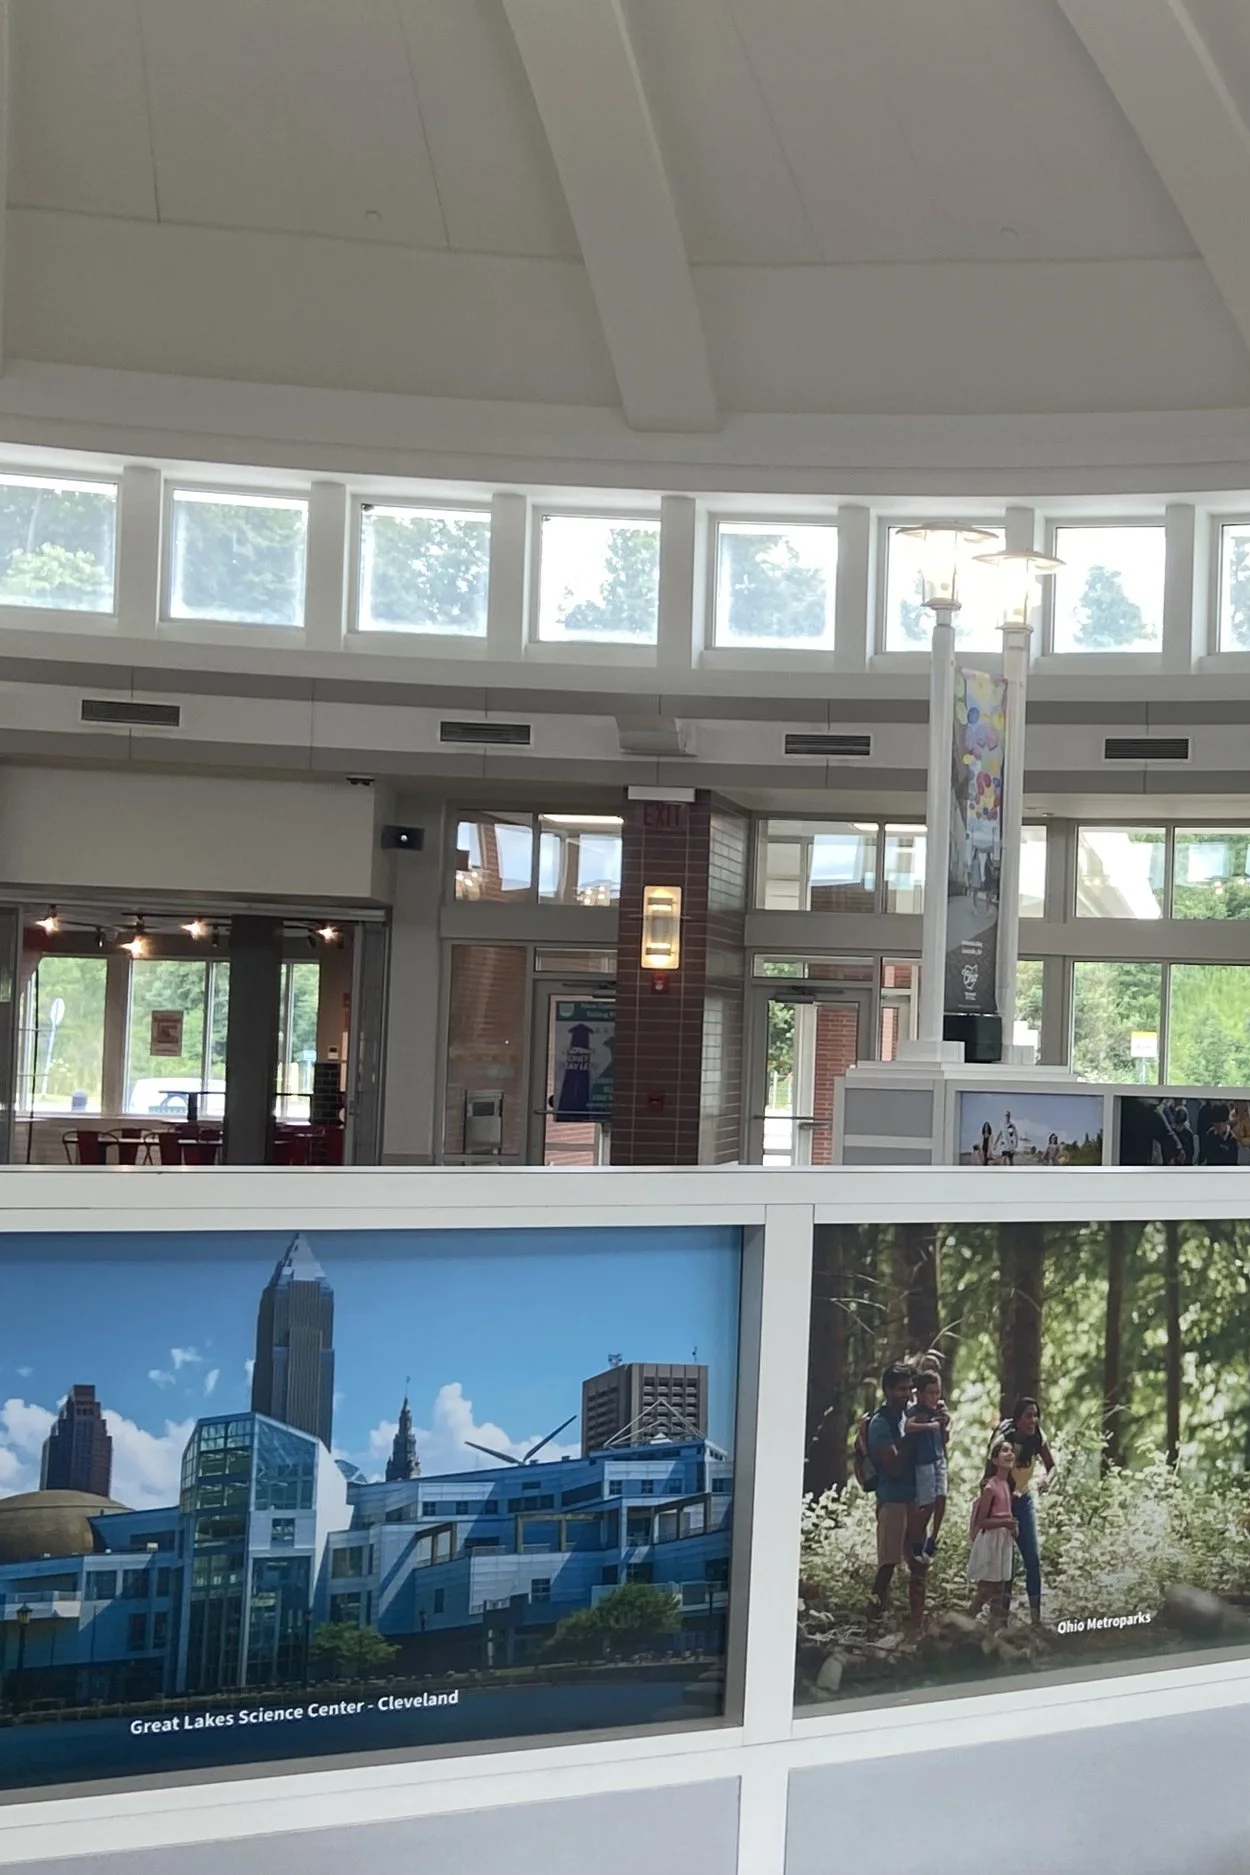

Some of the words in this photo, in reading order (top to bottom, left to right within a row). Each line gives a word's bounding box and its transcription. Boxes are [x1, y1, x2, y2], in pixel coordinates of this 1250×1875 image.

[644, 803, 682, 827] EXIT
[1057, 1619, 1085, 1634] Ohio
[1086, 1611, 1151, 1630] Metroparks
[130, 1716, 179, 1735] Great
[184, 1711, 234, 1730] Lakes
[238, 1706, 303, 1725] Science
[307, 1700, 365, 1719] Center
[377, 1689, 459, 1711] Cleveland
